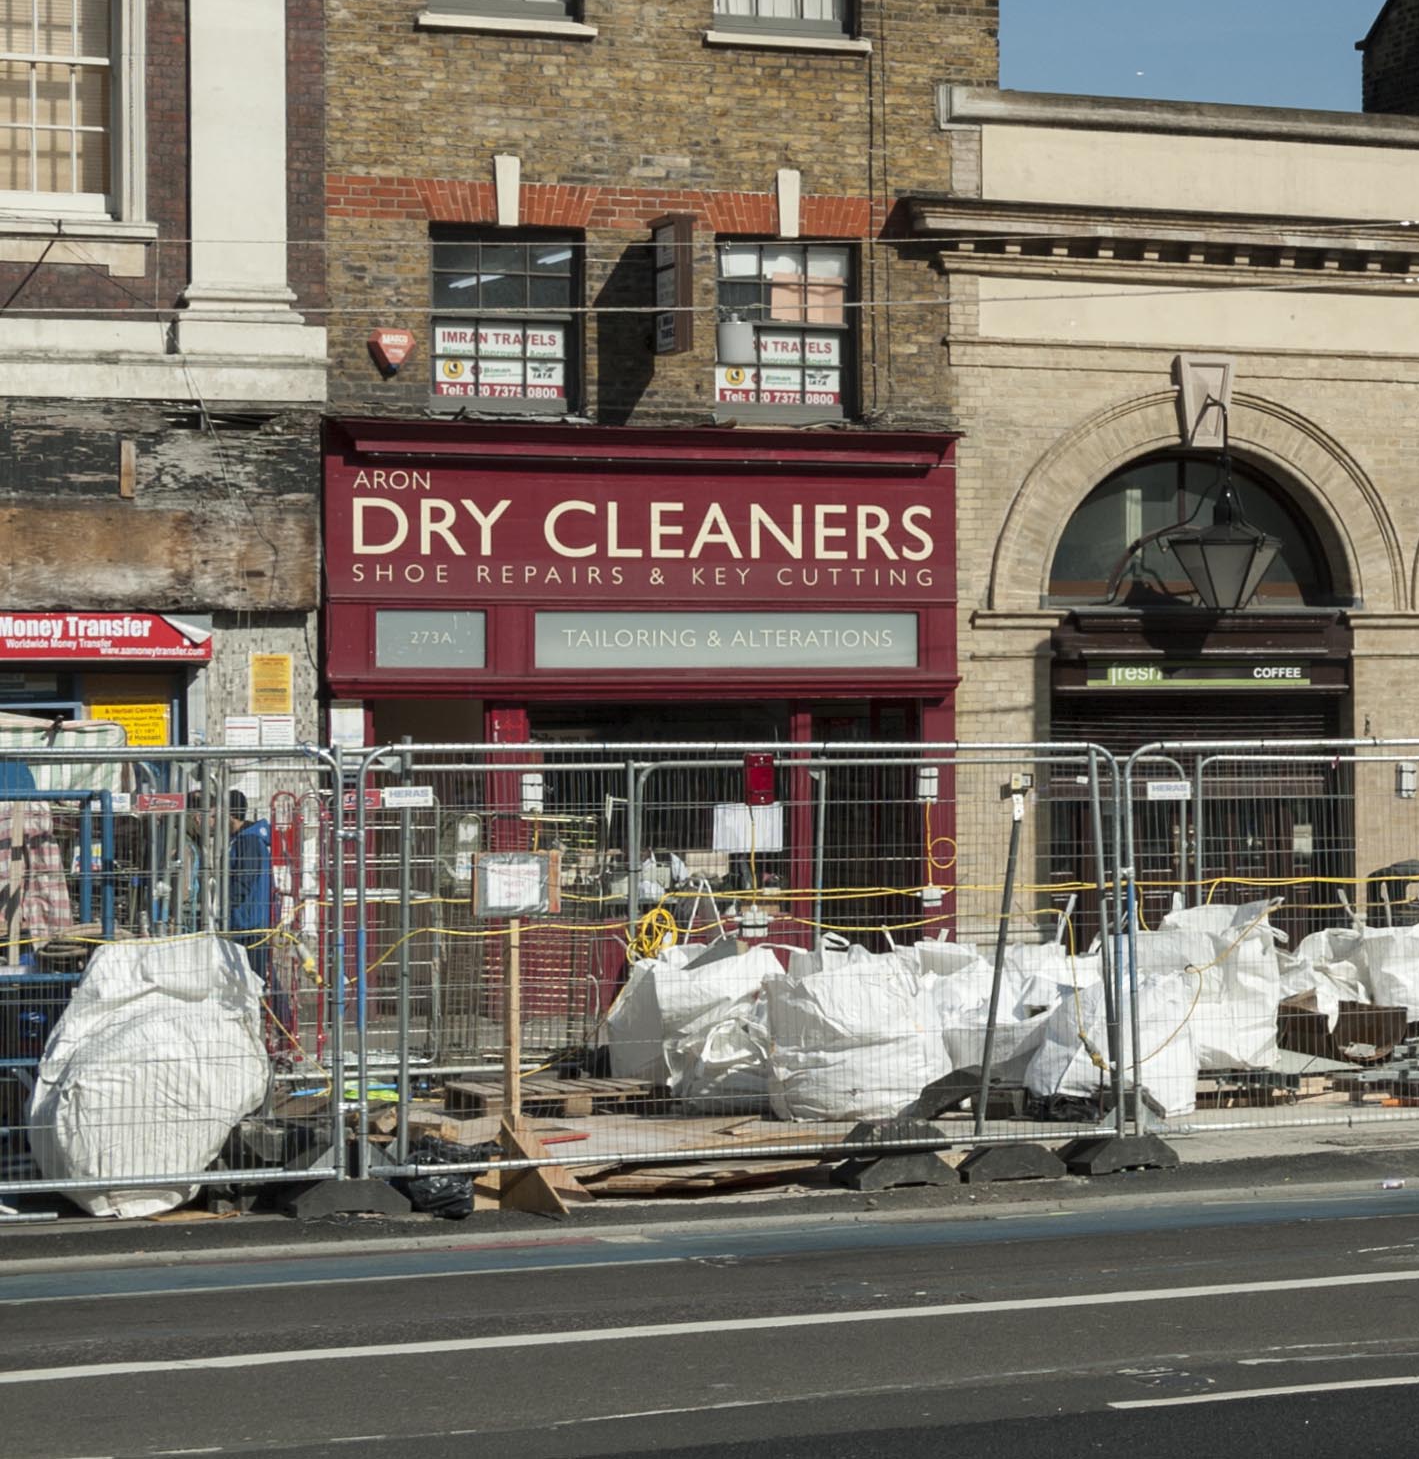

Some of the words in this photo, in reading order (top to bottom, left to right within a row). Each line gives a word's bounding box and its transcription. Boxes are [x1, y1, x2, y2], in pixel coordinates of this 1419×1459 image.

[442, 331, 488, 344] IMRAN
[441, 383, 465, 396] Tel:
[526, 386, 558, 399] 0800
[723, 391, 747, 403] Tel:
[805, 393, 835, 405] 0800
[353, 470, 431, 491] ARON
[353, 497, 512, 556] DRY
[543, 499, 934, 561] CLEANERS
[352, 563, 449, 583] SHOE
[477, 564, 625, 586] REPAIRS
[649, 565, 665, 585] &
[692, 567, 751, 586] KEY
[777, 568, 934, 587] CUTTING
[0, 617, 63, 638] Money
[66, 616, 152, 637] Transfer
[6, 638, 49, 648] Worldwide
[51, 639, 77, 650] Money
[79, 638, 112, 648] Transfer
[411, 629, 453, 645] 273A
[562, 628, 696, 648] TAILORING
[706, 629, 722, 648] &
[730, 629, 894, 649] ALTERATIONS
[1253, 667, 1302, 679] COFFEE
[388, 790, 429, 799] HERAS
[1151, 783, 1187, 793] HERAS
